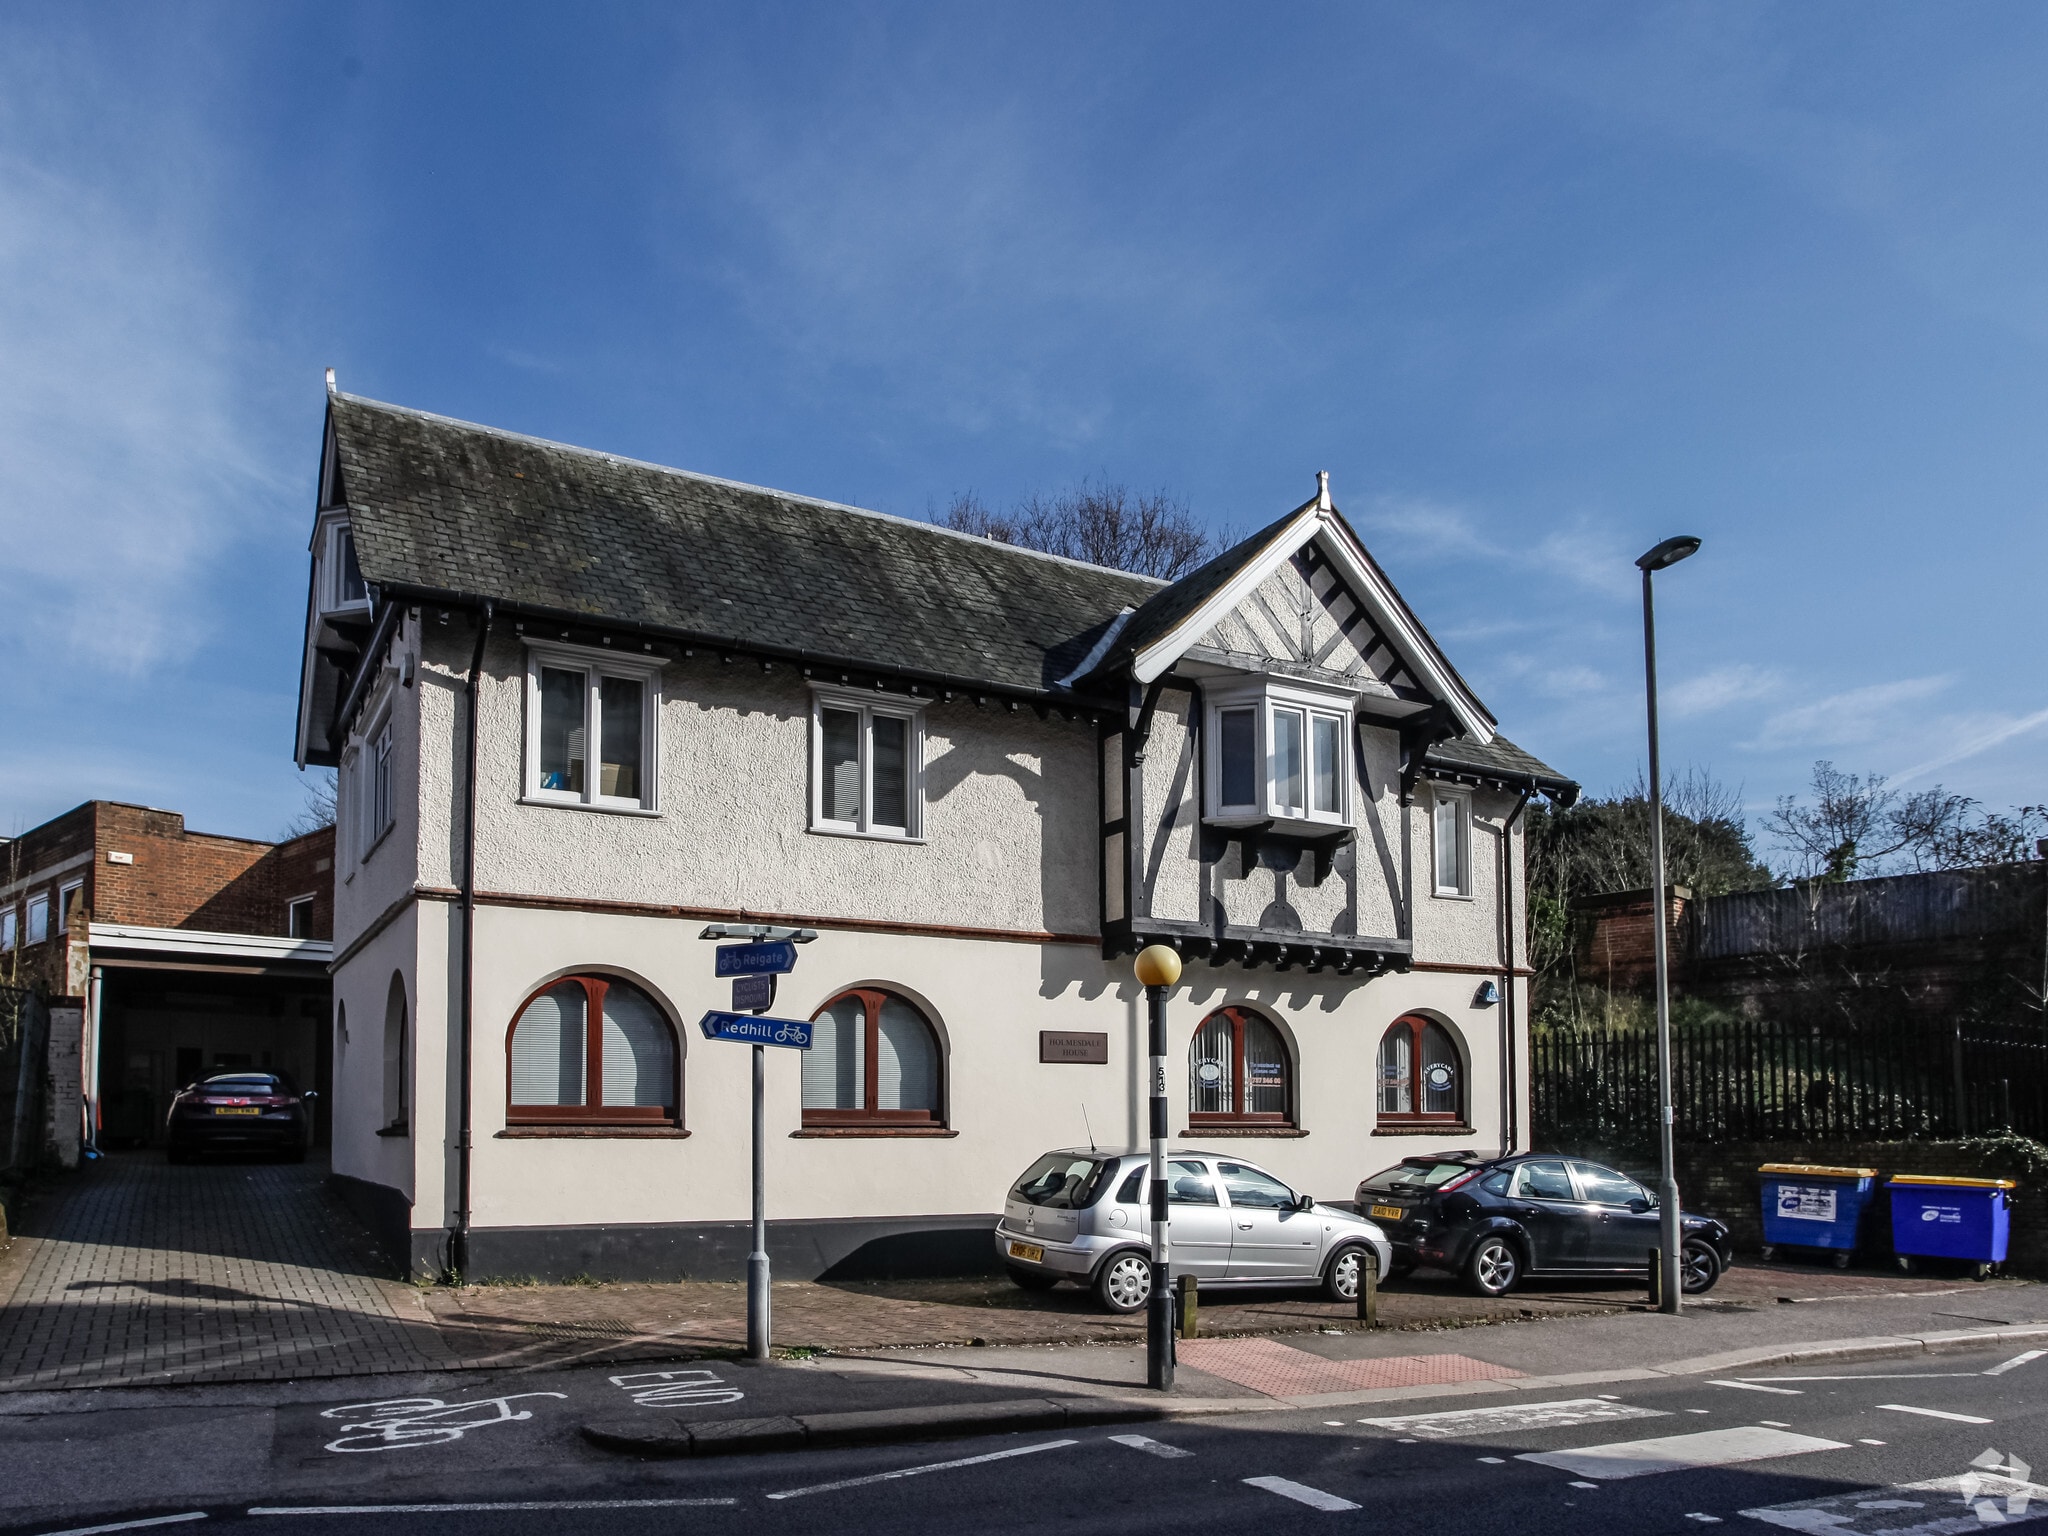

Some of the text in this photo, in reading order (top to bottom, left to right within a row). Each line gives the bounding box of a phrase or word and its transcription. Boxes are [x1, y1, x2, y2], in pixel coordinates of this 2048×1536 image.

[743, 952, 783, 966] Reigate
[736, 980, 766, 993] CYCLISTS
[735, 992, 766, 1005] DISMOUNT
[720, 1020, 772, 1037] Redhill
[1049, 1038, 1102, 1047] HOLMESDALE
[1062, 1049, 1088, 1057] HOUSE
[1387, 1207, 1400, 1218] YVR
[608, 1370, 744, 1407] END
